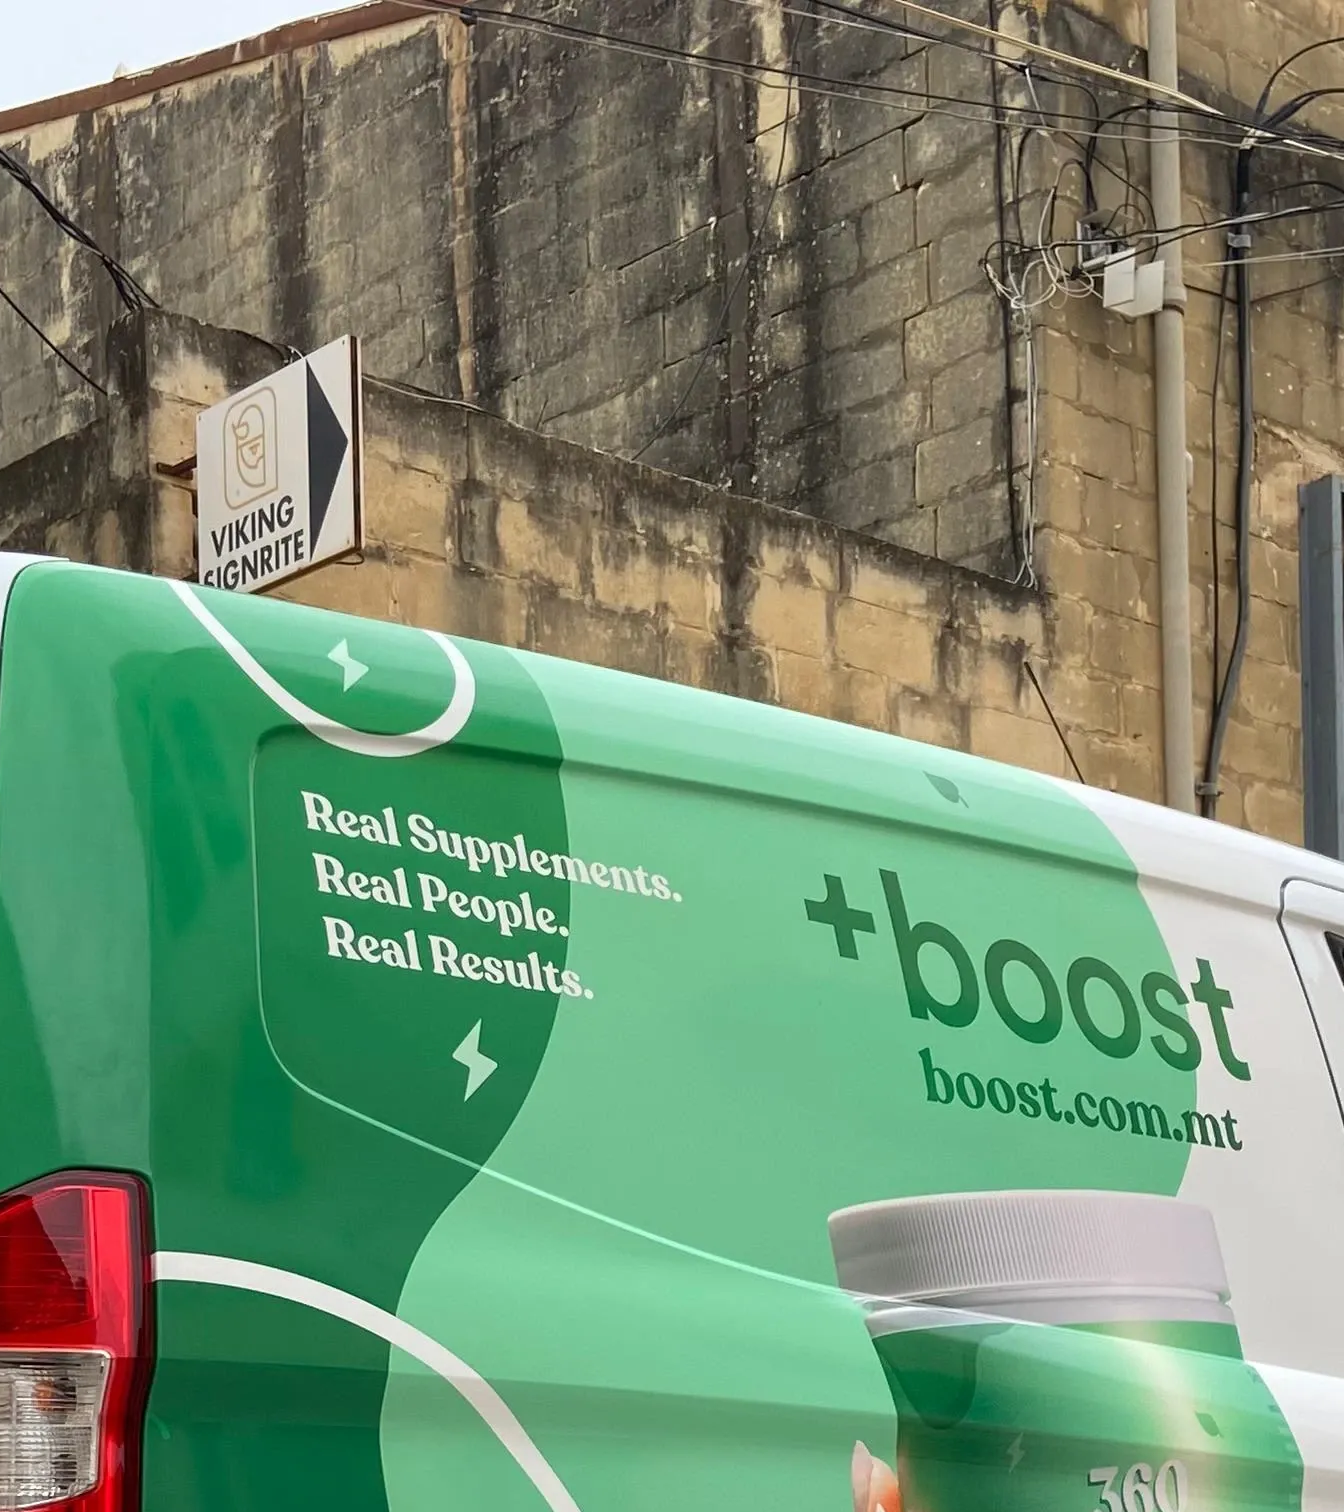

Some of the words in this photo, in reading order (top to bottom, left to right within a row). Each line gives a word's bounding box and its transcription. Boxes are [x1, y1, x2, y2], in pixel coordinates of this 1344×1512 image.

[211, 496, 295, 558] VIKING
[301, 790, 401, 848] Real
[408, 813, 683, 903] Supplements.
[312, 852, 412, 909] Real
[417, 872, 570, 937] People.
[322, 915, 422, 971] Real
[428, 933, 594, 1000] Results.
[918, 1047, 1243, 1152] boost.com.mt
